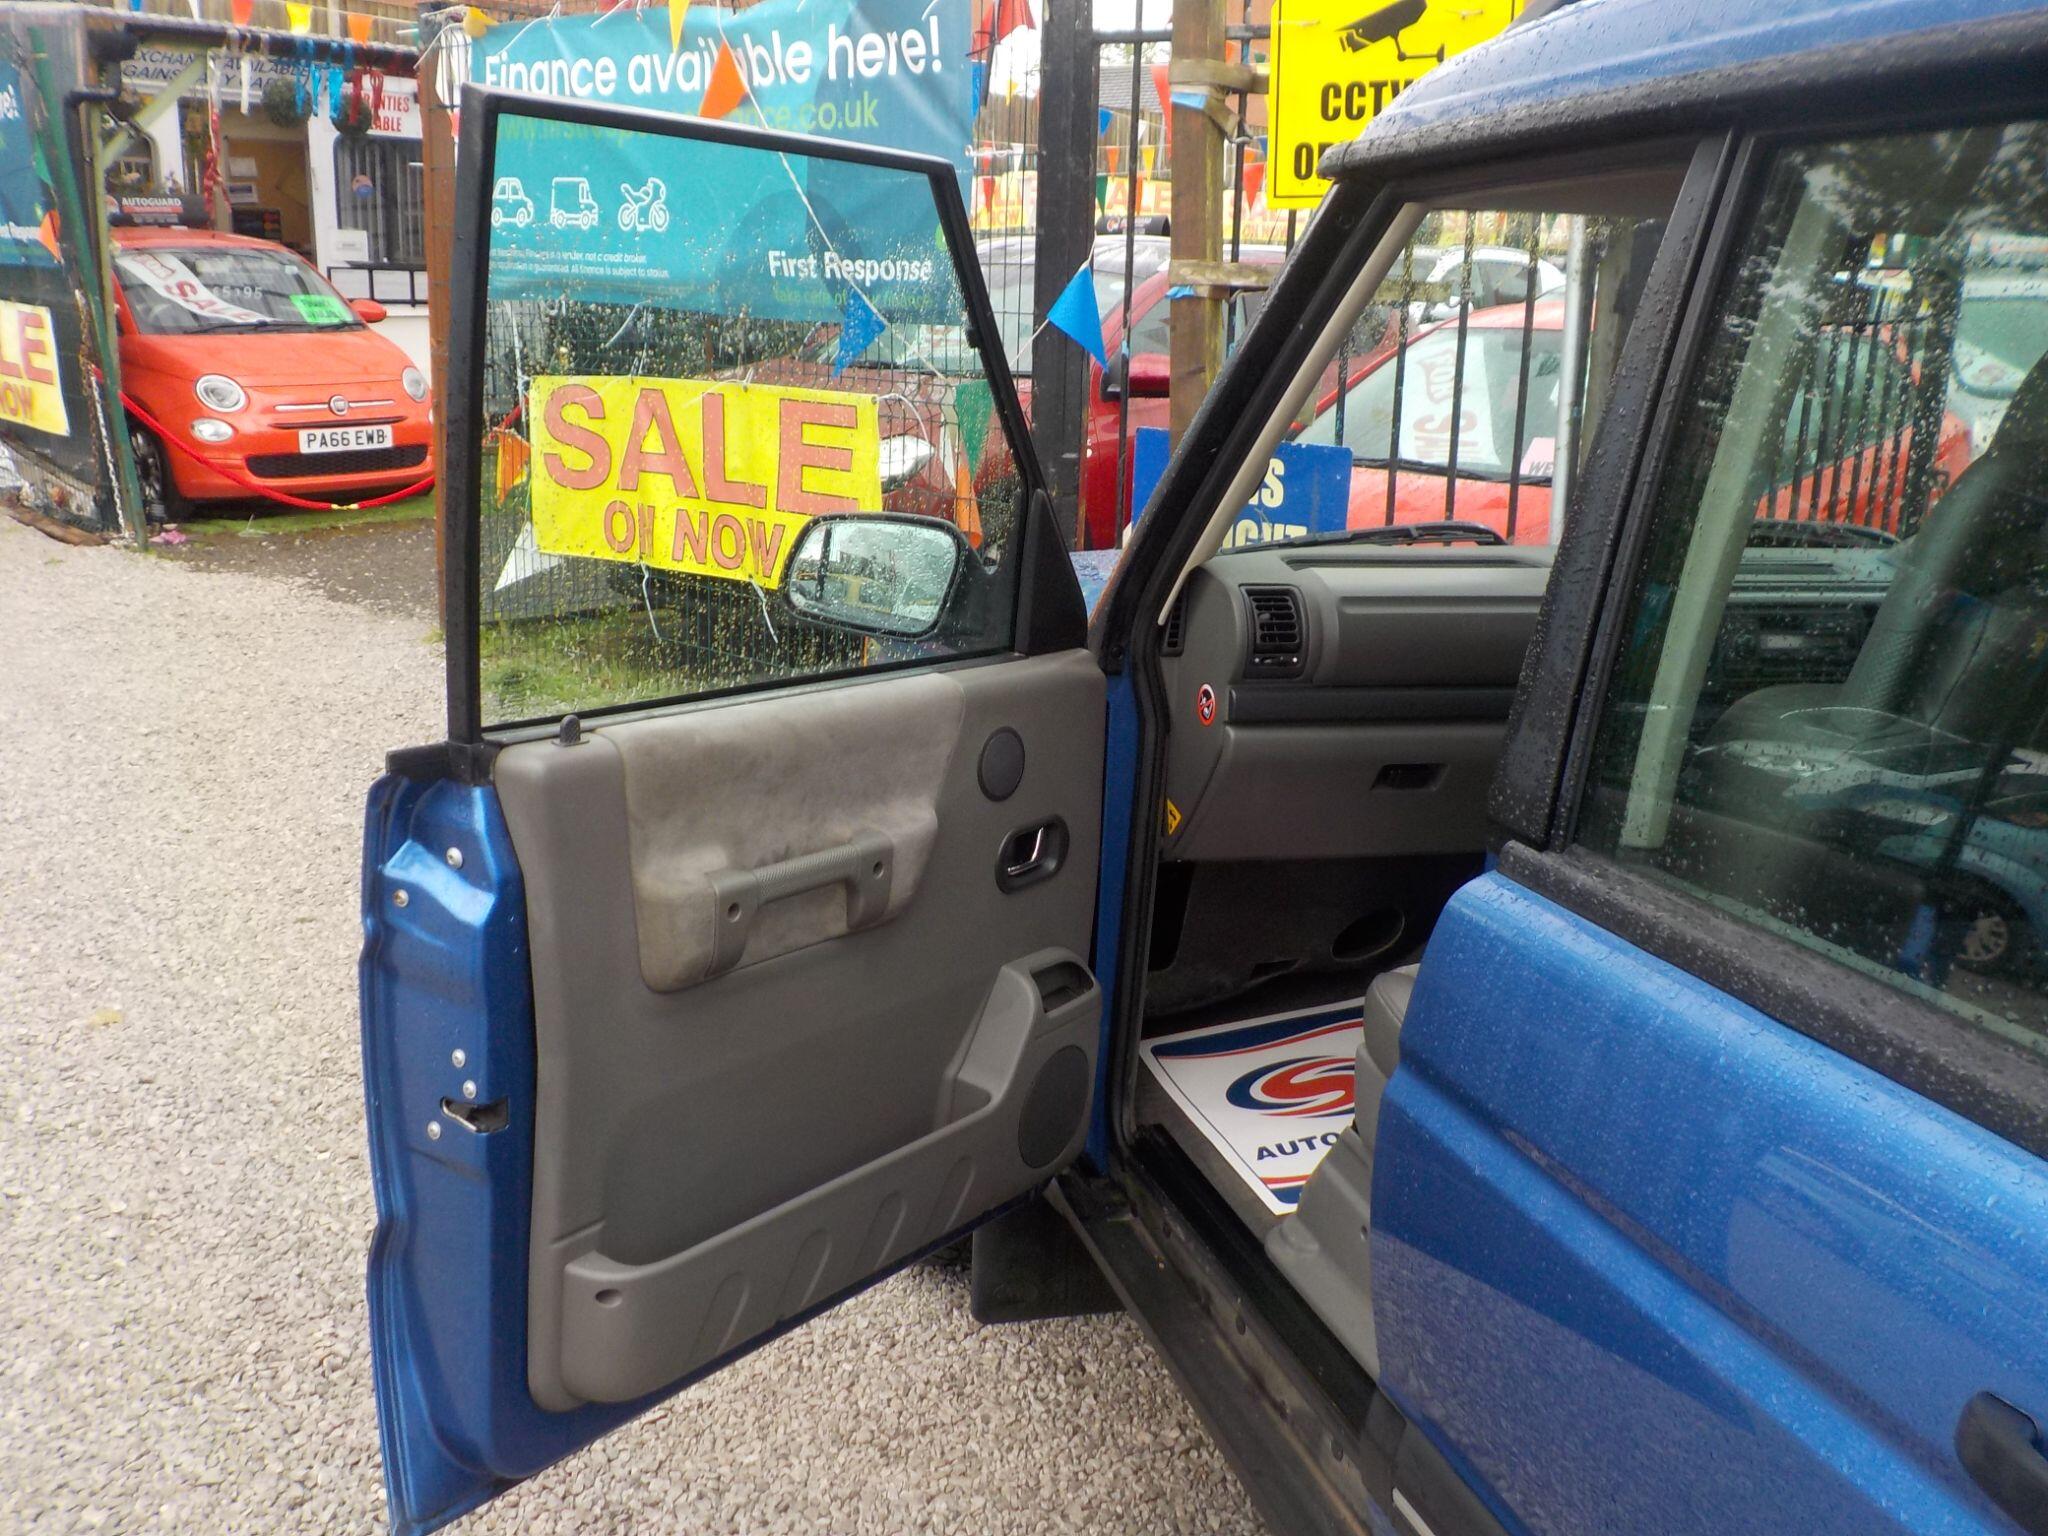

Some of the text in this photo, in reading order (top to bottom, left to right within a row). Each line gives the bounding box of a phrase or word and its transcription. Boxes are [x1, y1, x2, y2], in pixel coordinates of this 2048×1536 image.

[485, 15, 942, 96] Finance avaible here!
[122, 197, 182, 208] AUTOGUARD
[768, 250, 933, 287] First Response
[0, 310, 54, 386] LE
[306, 428, 386, 449] PA66 EWB
[543, 383, 860, 515] SALE
[603, 500, 786, 579] ON NOW
[1256, 1131, 1340, 1161] AUTO
